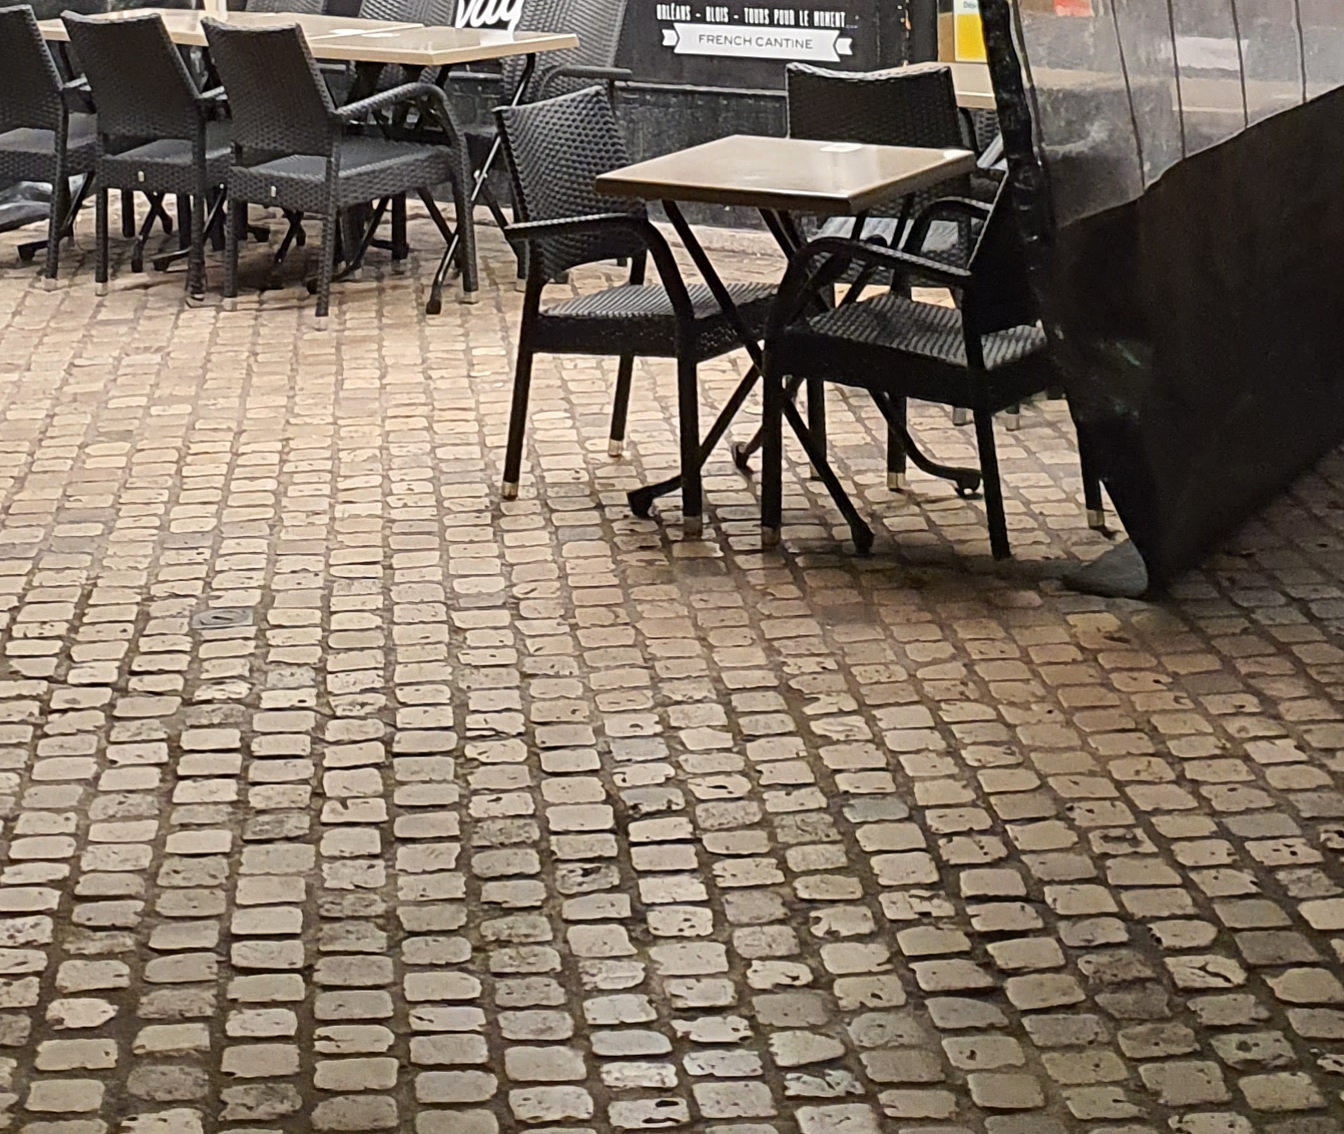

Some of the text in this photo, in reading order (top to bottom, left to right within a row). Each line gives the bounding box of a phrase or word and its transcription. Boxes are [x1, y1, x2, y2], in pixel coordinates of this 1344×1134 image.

[773, 8, 795, 26] POUR
[799, 9, 809, 27] LE
[698, 34, 814, 50] FRENCH CANTINE
